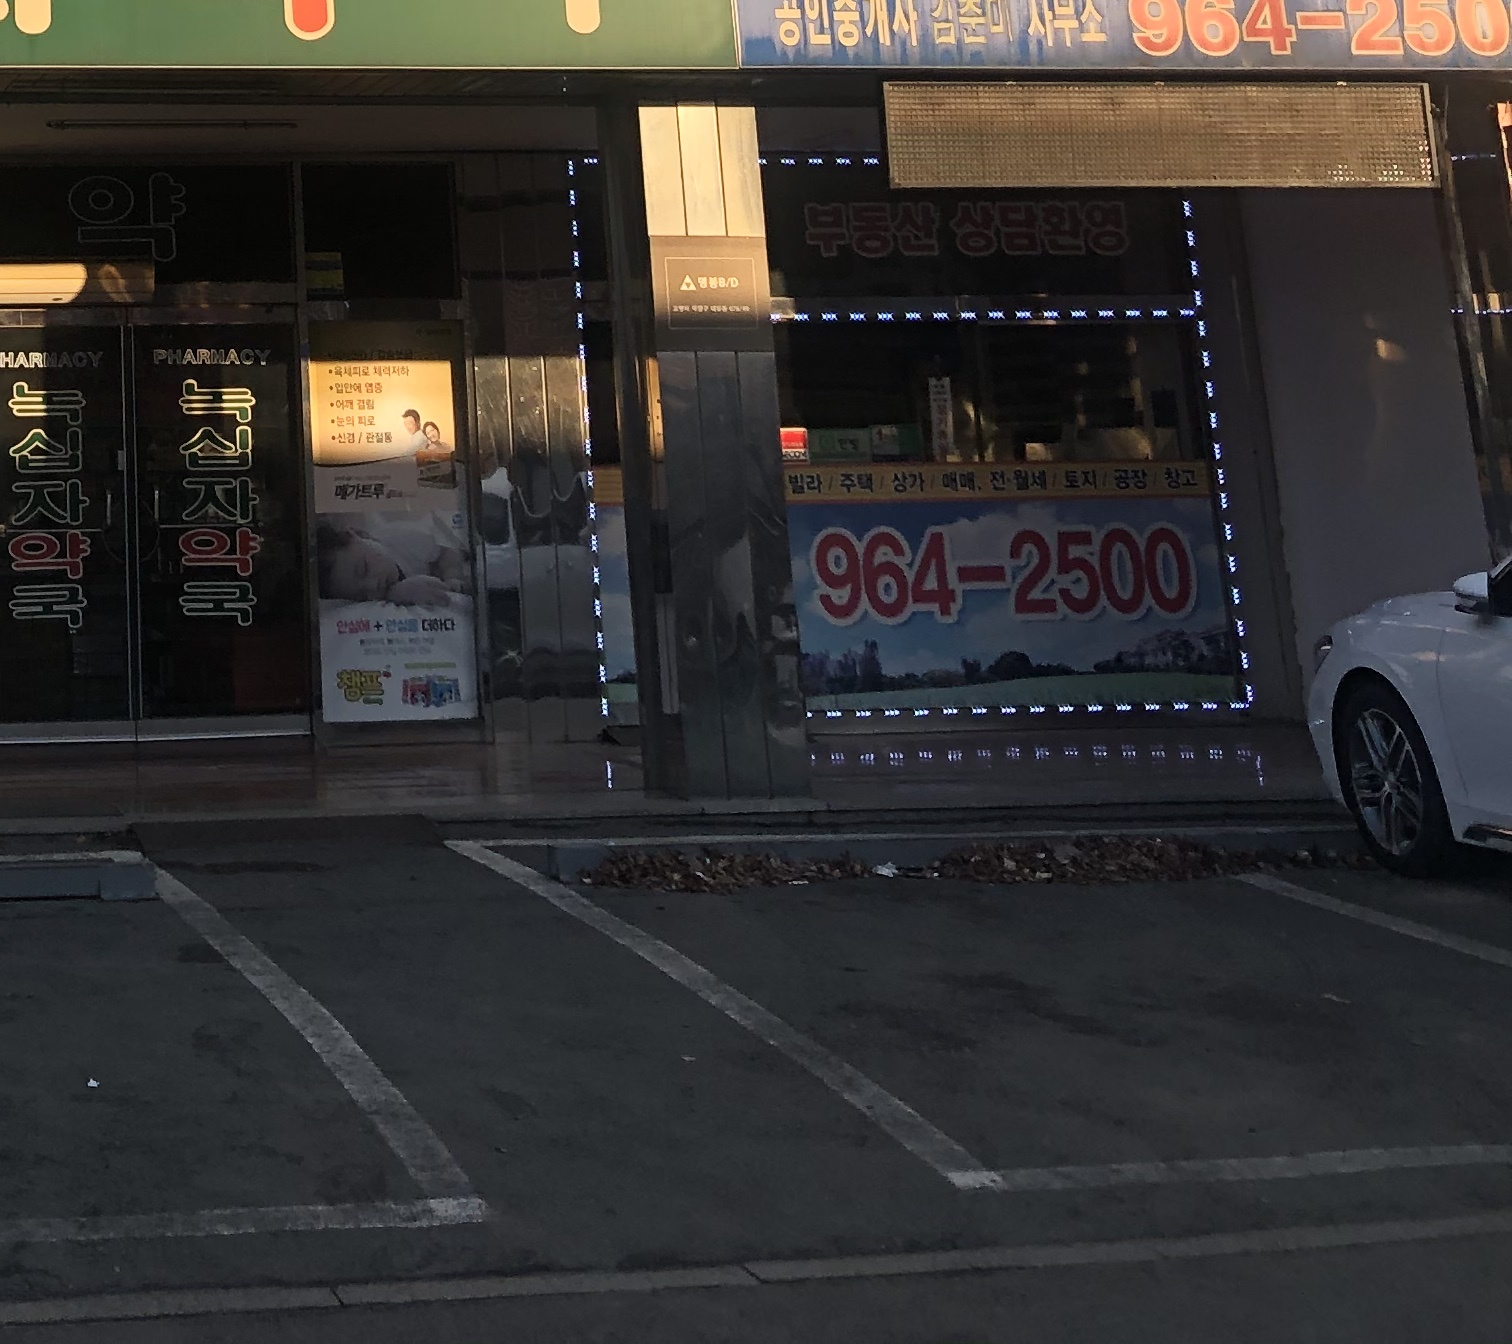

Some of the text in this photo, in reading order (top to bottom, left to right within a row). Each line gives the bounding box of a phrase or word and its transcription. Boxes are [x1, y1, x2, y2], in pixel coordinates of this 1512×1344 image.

[68, 171, 187, 262] 약
[805, 200, 1129, 258] 부동산 상담환영
[153, 348, 271, 366] PHARMACY
[788, 473, 823, 495] 빌라
[839, 472, 874, 494] 주택
[892, 470, 926, 492] 상가
[1063, 468, 1098, 490] 토지
[1114, 467, 1148, 490] 공장
[1164, 467, 1199, 488] 창고
[813, 524, 1195, 621] 964-2500
